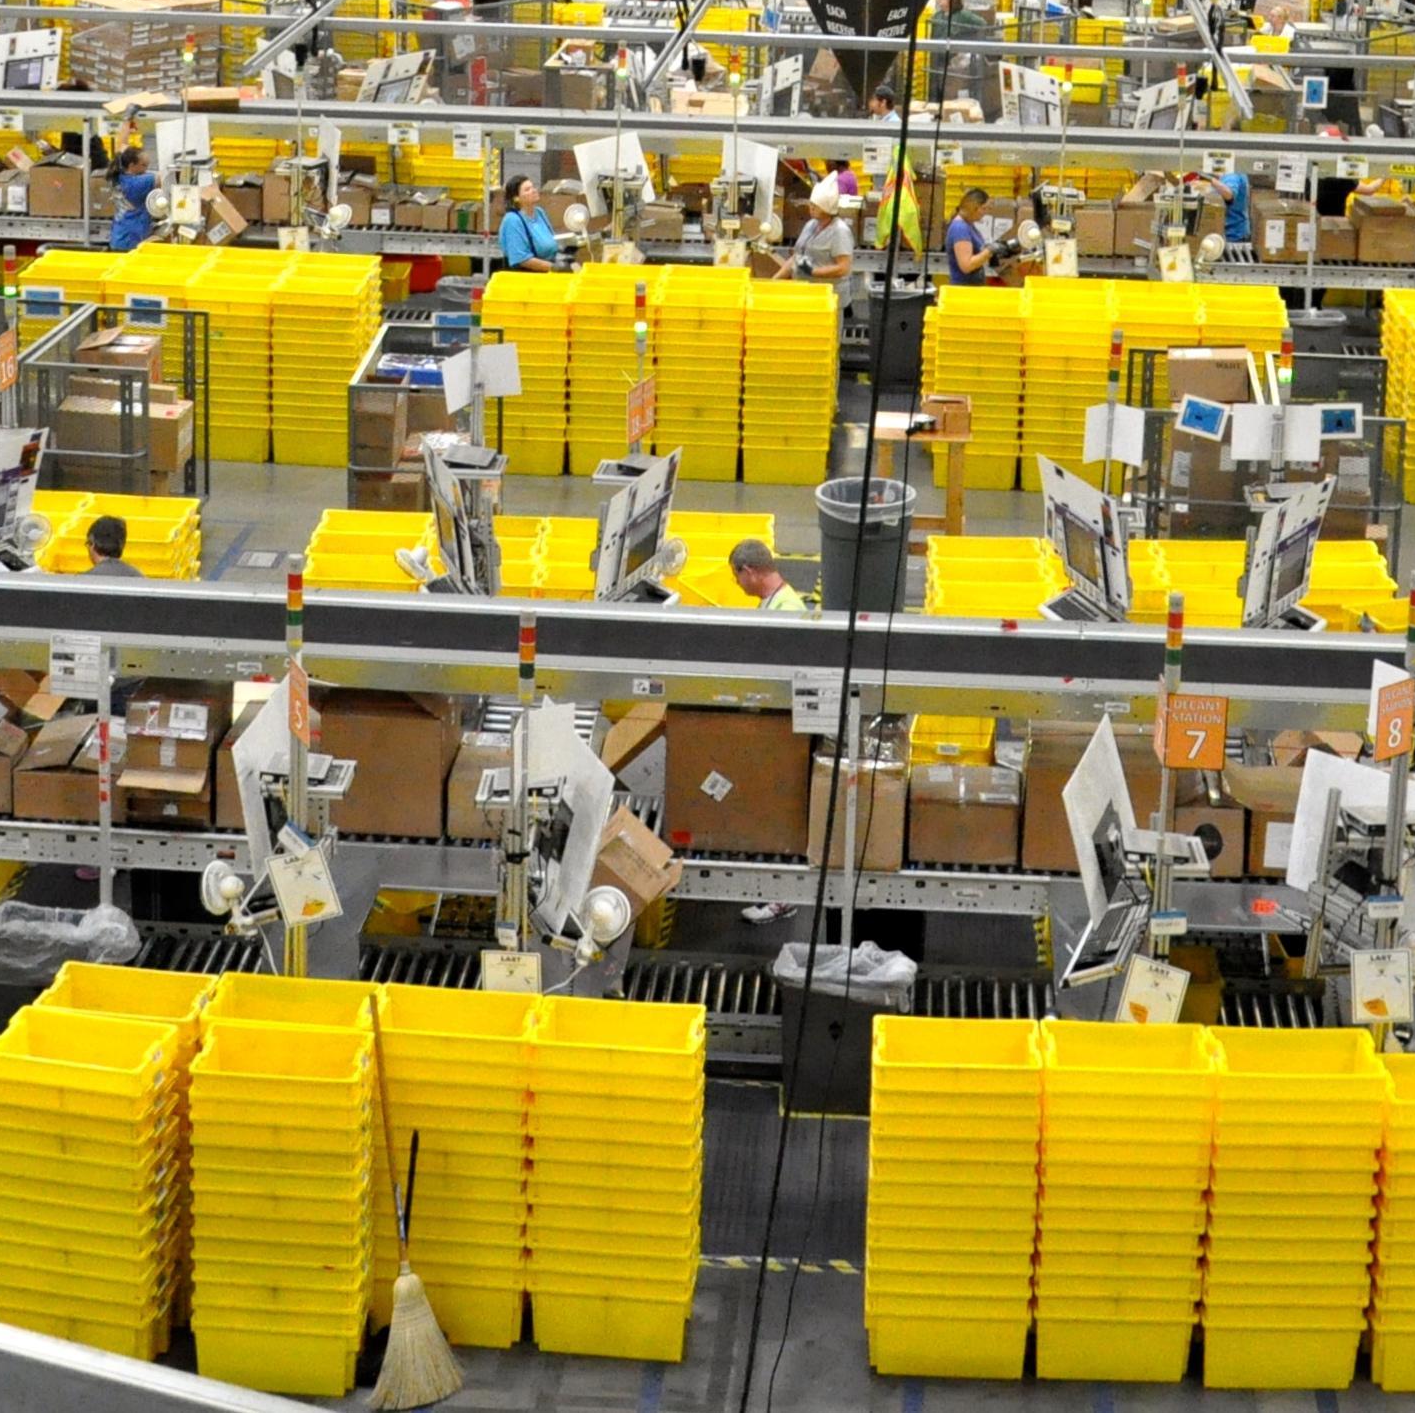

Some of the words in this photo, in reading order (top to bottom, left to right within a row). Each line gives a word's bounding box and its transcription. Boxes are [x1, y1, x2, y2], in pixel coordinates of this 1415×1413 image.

[825, 2, 848, 20] EACH
[886, 6, 909, 23] EACH
[1, 355, 15, 384] 16
[1174, 699, 1220, 711] DECANT
[1172, 712, 1221, 724] STATION
[1388, 717, 1402, 748] 8
[1186, 730, 1207, 760] 7
